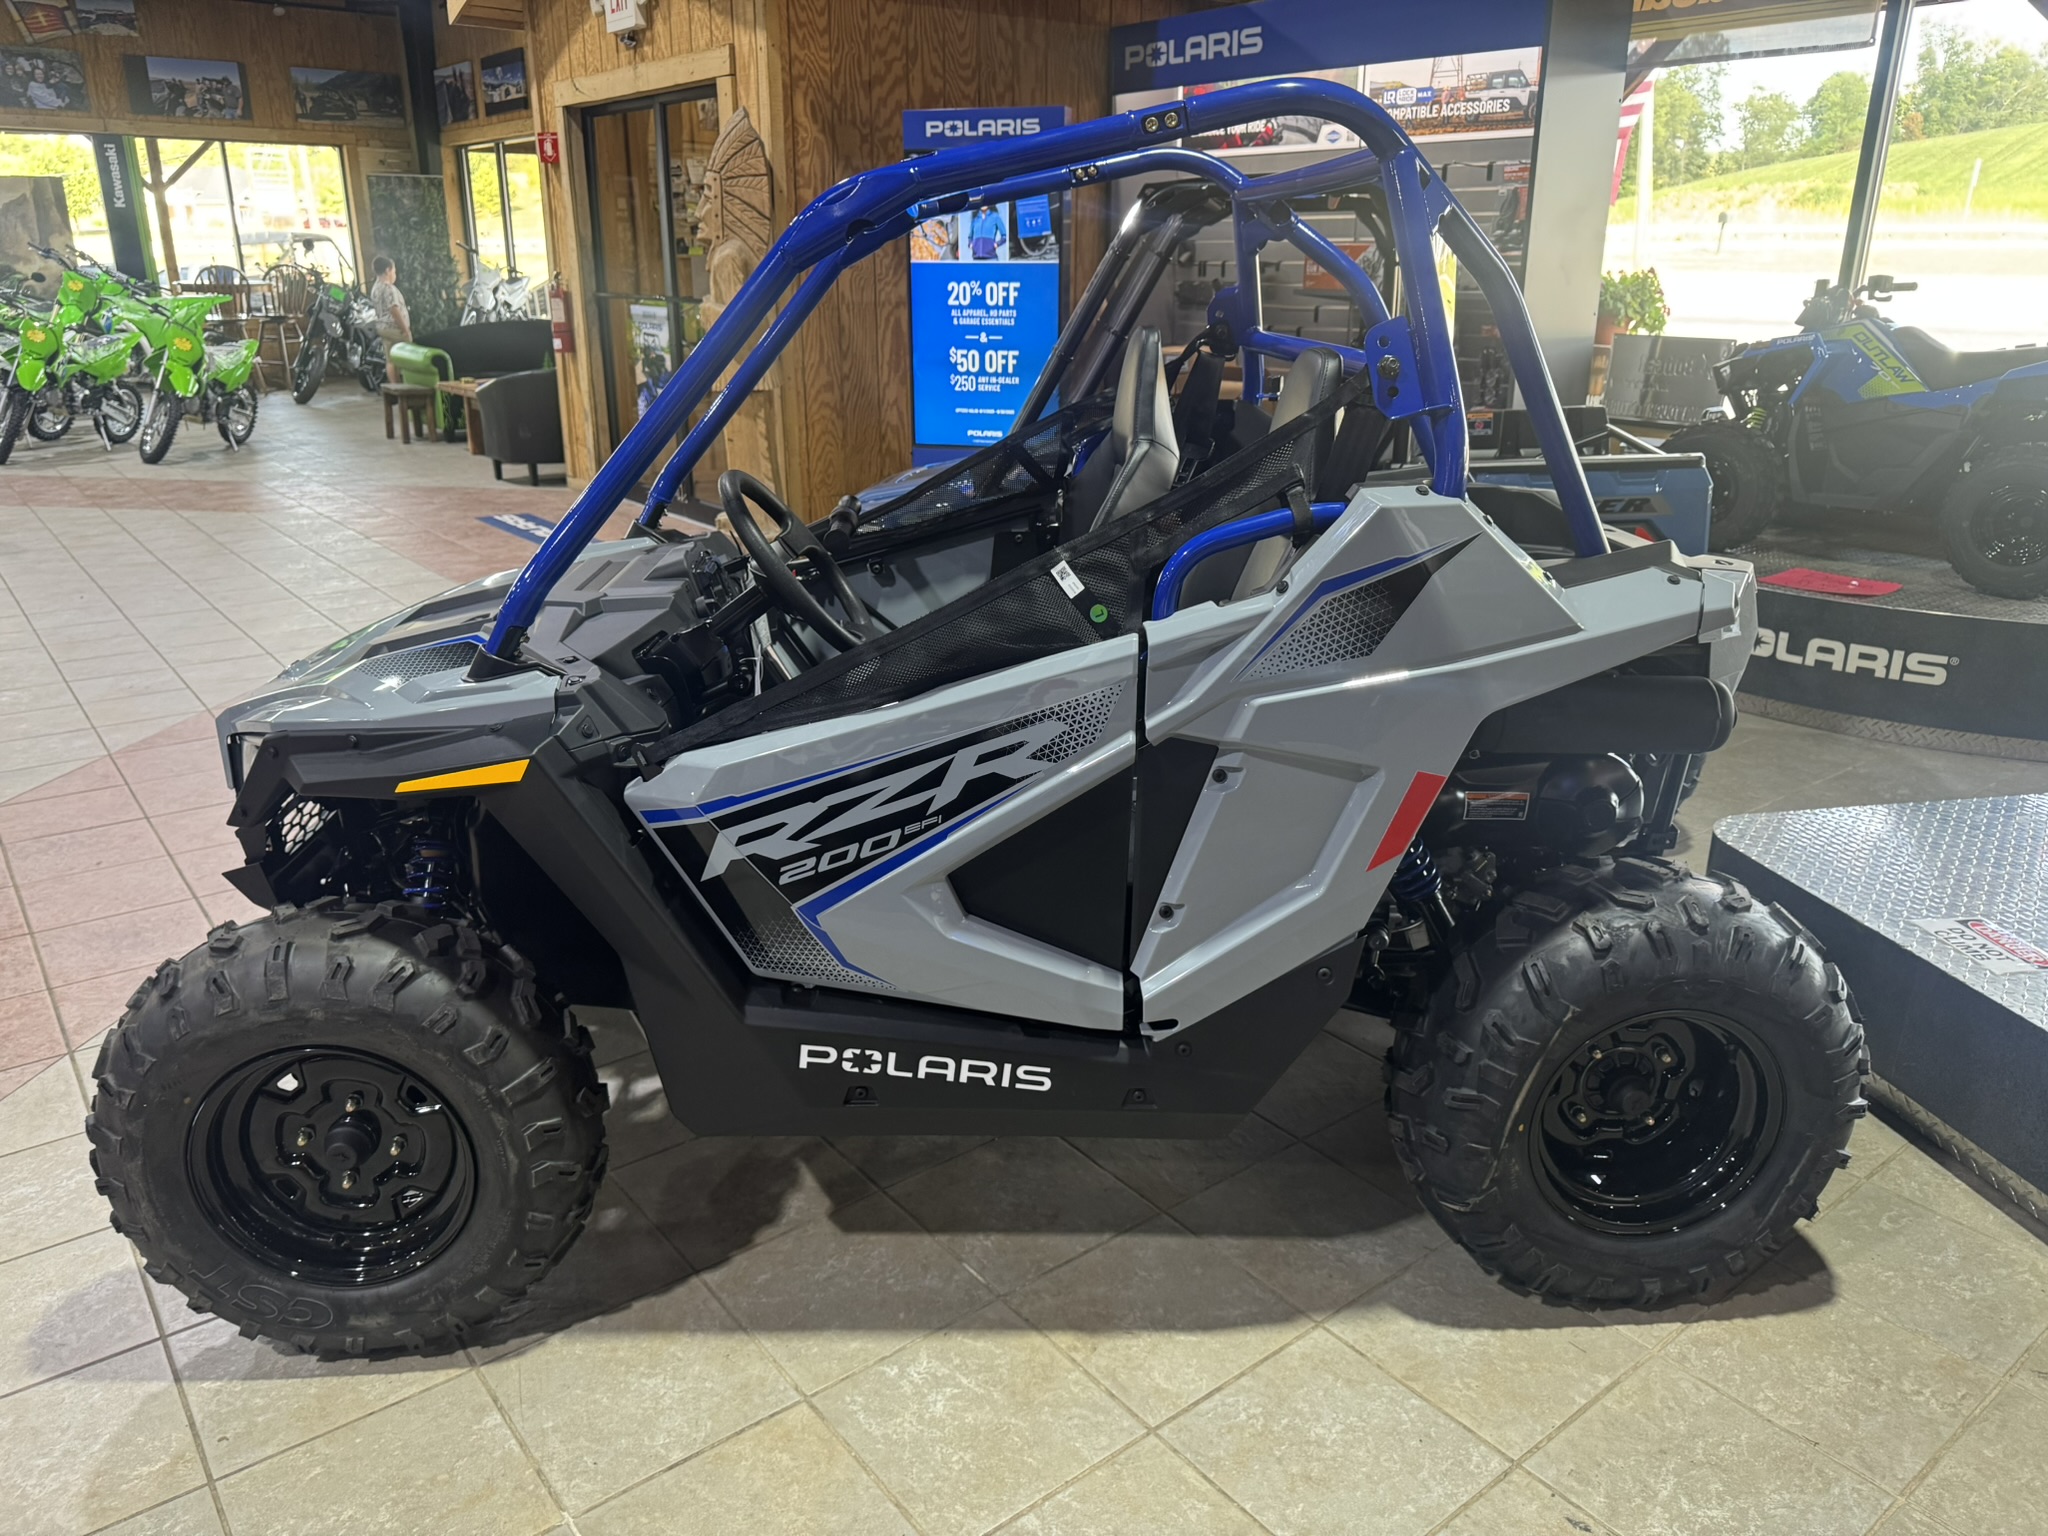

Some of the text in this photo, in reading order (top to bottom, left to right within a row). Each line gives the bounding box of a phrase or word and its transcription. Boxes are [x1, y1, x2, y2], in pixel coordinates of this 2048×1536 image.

[1124, 26, 1264, 71] POLARIS
[1386, 99, 1511, 121] OMPATIBLE ACCESSORIES
[925, 118, 1041, 138] POLARIS
[104, 143, 126, 208] Kawasaki
[947, 280, 1021, 306] 20% OFF
[951, 308, 961, 317] ALL
[999, 309, 1017, 318] PARTS
[981, 317, 1015, 326] ESSENTIALS
[979, 331, 988, 343] &
[1776, 334, 1816, 345] POLARIS
[949, 346, 1019, 374] $50 OFF
[1853, 331, 1915, 383] OUTLAW
[950, 373, 976, 392] $250
[978, 376, 989, 384] ANY
[978, 384, 1001, 392] SERVICE
[700, 719, 1067, 882] RZR
[778, 814, 943, 886] 200 EFI
[1934, 930, 1991, 962] CLIMB
[1948, 927, 2015, 962] DO NOT
[799, 1044, 1053, 1093] POLARIS
